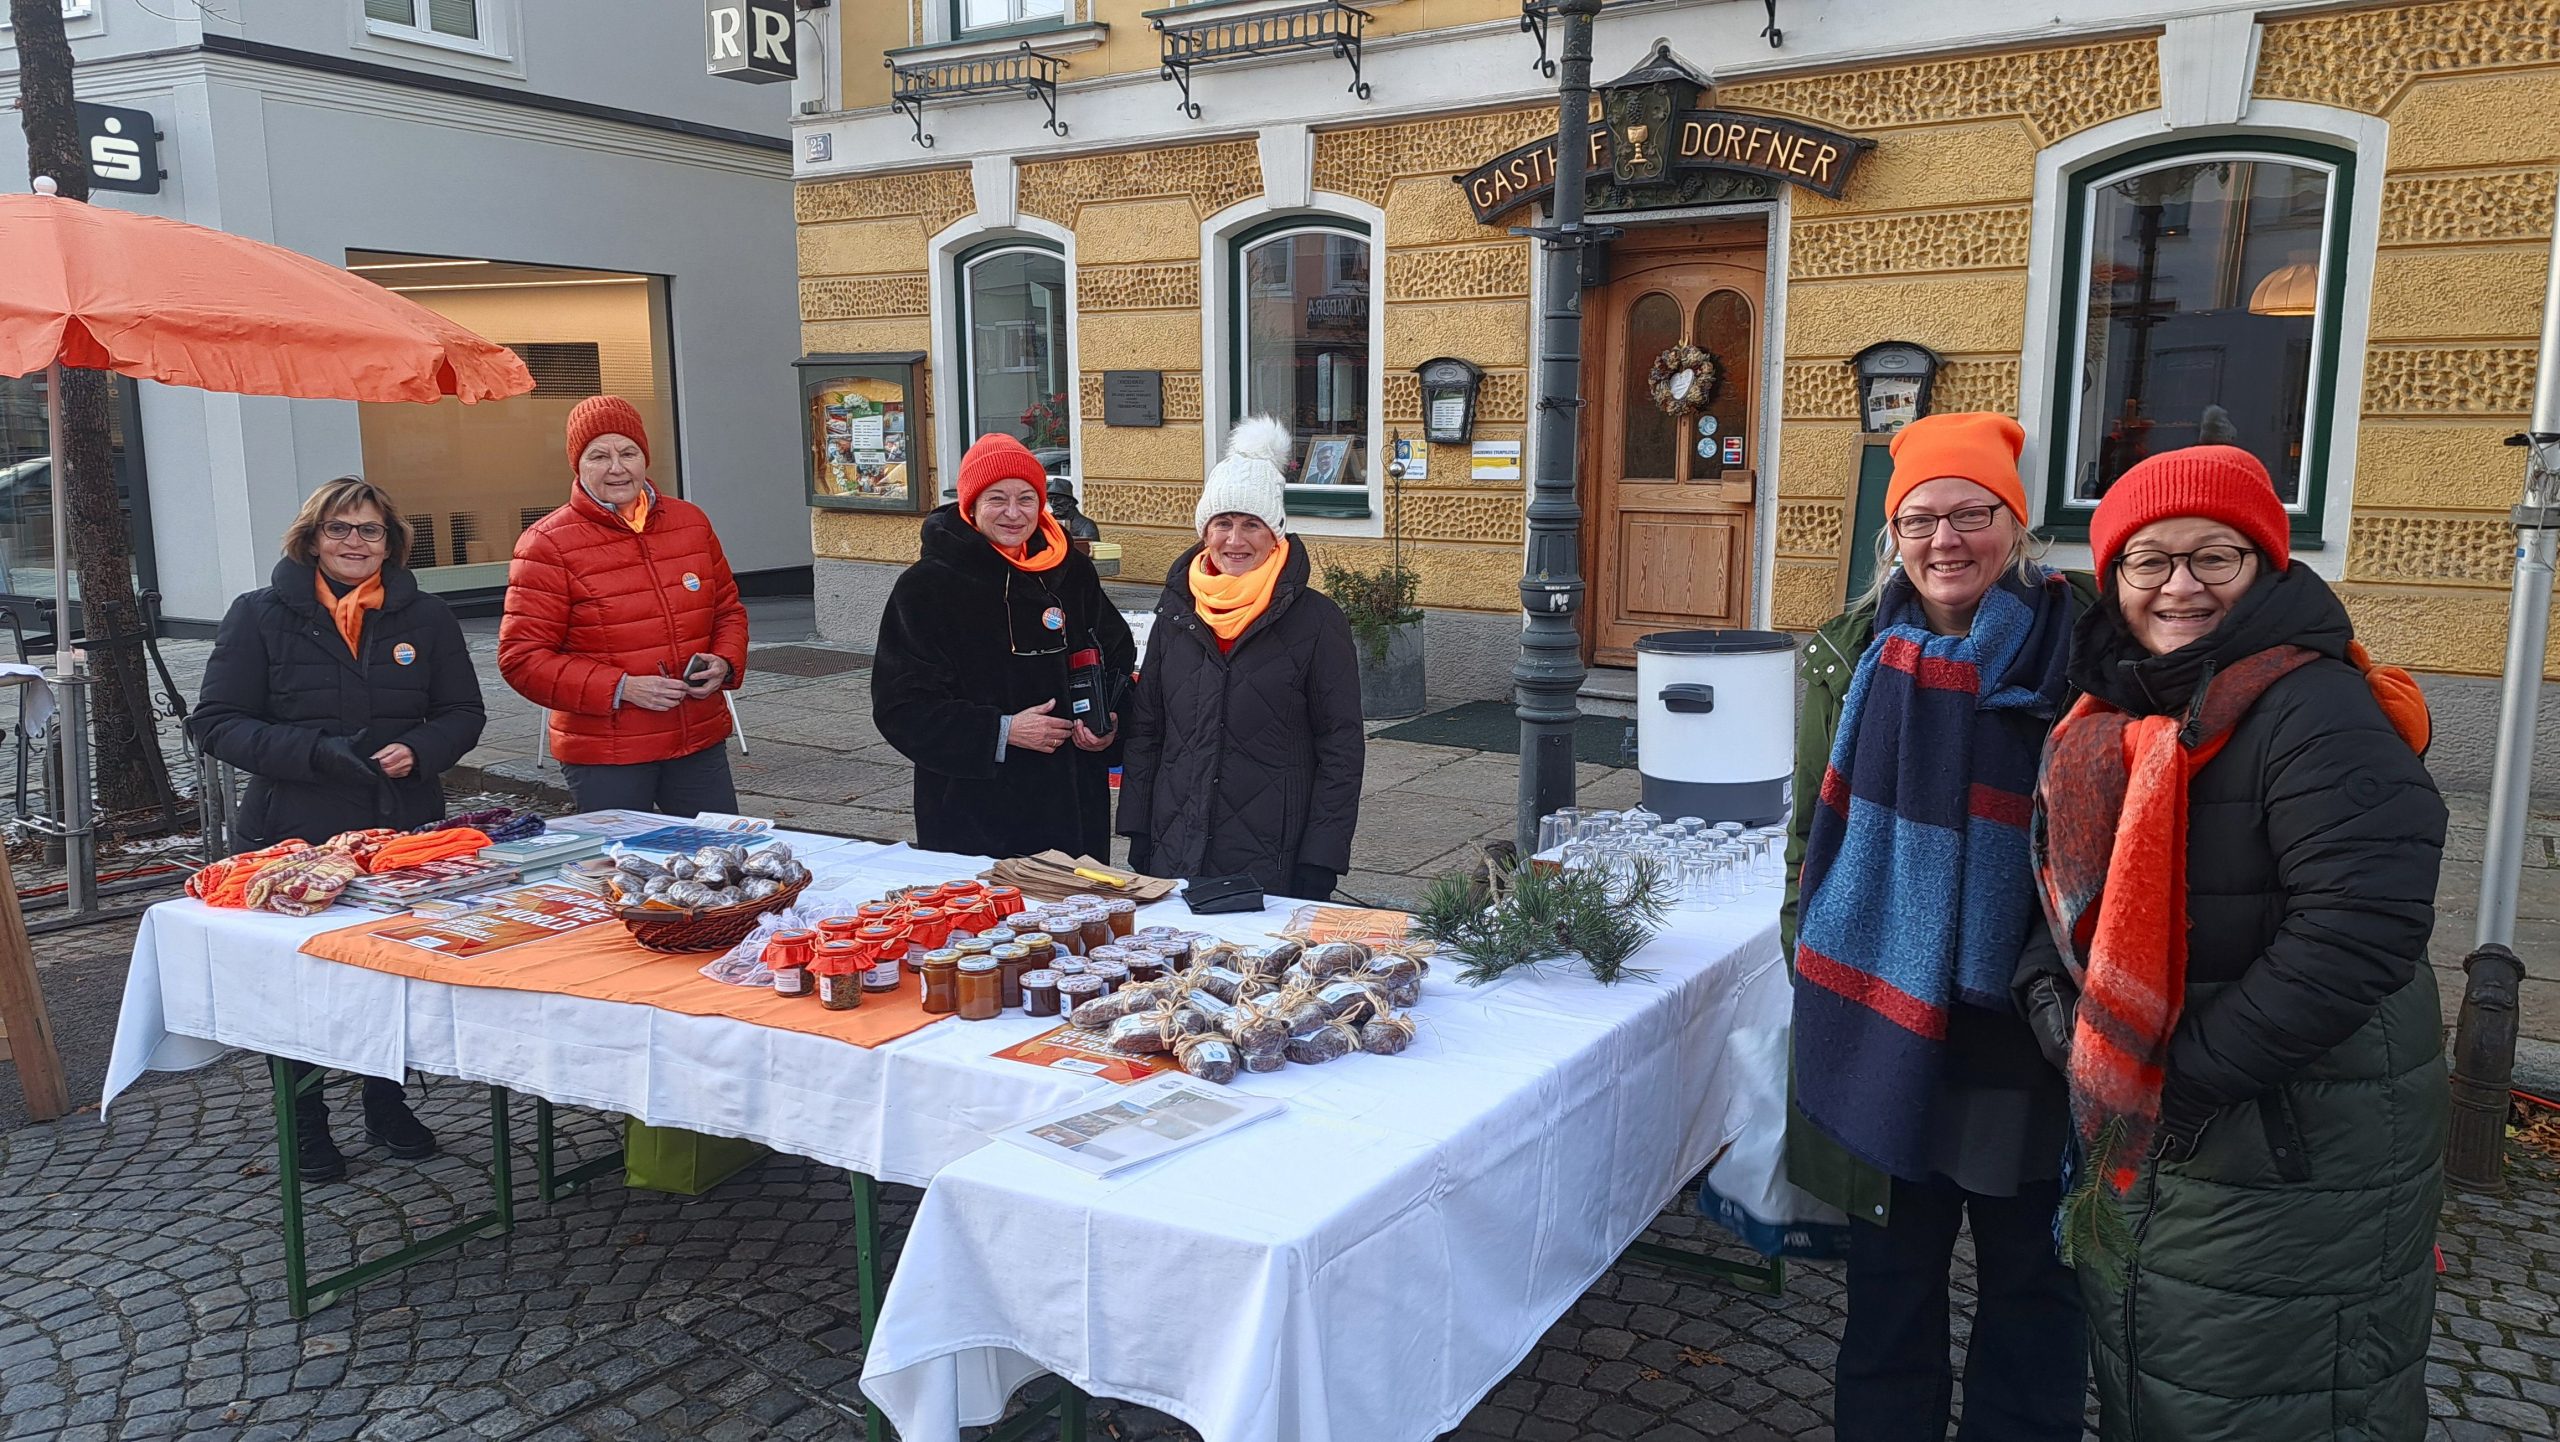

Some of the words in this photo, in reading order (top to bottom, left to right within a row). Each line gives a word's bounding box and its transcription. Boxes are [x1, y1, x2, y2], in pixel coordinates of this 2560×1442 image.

[810, 138, 824, 152] 25
[1473, 130, 1608, 208] GASTHF
[1681, 122, 1838, 182] DORFNER
[494, 908, 581, 930] WORLD
[557, 906, 614, 922] THE
[1047, 1035, 1075, 1045] AN
